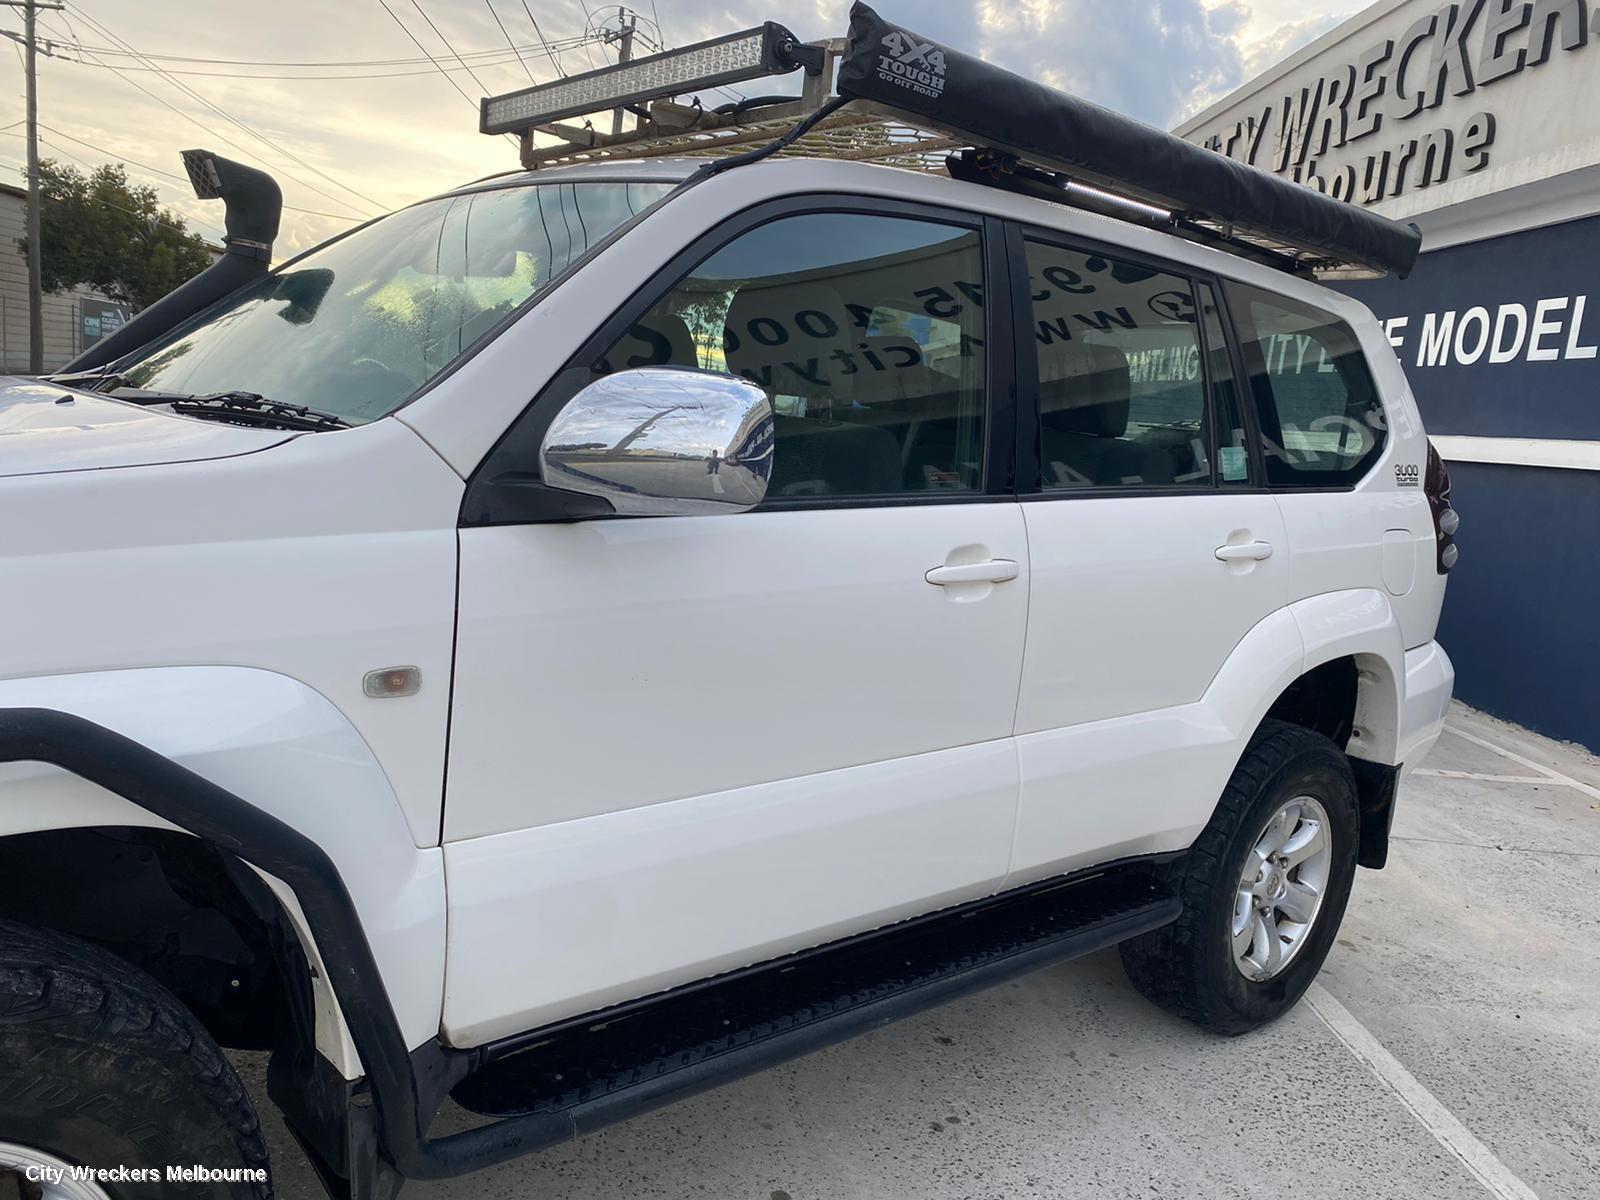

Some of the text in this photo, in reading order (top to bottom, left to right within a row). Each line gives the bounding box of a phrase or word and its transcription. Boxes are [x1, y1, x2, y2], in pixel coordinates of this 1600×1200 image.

[879, 55, 946, 91] TOUGH
[879, 72, 893, 82] GO
[913, 85, 939, 98] ROAD
[1273, 0, 1600, 172] WRECKER
[1289, 112, 1497, 205] bourne
[1416, 295, 1599, 368] MODEL
[1394, 464, 1419, 476] 3000
